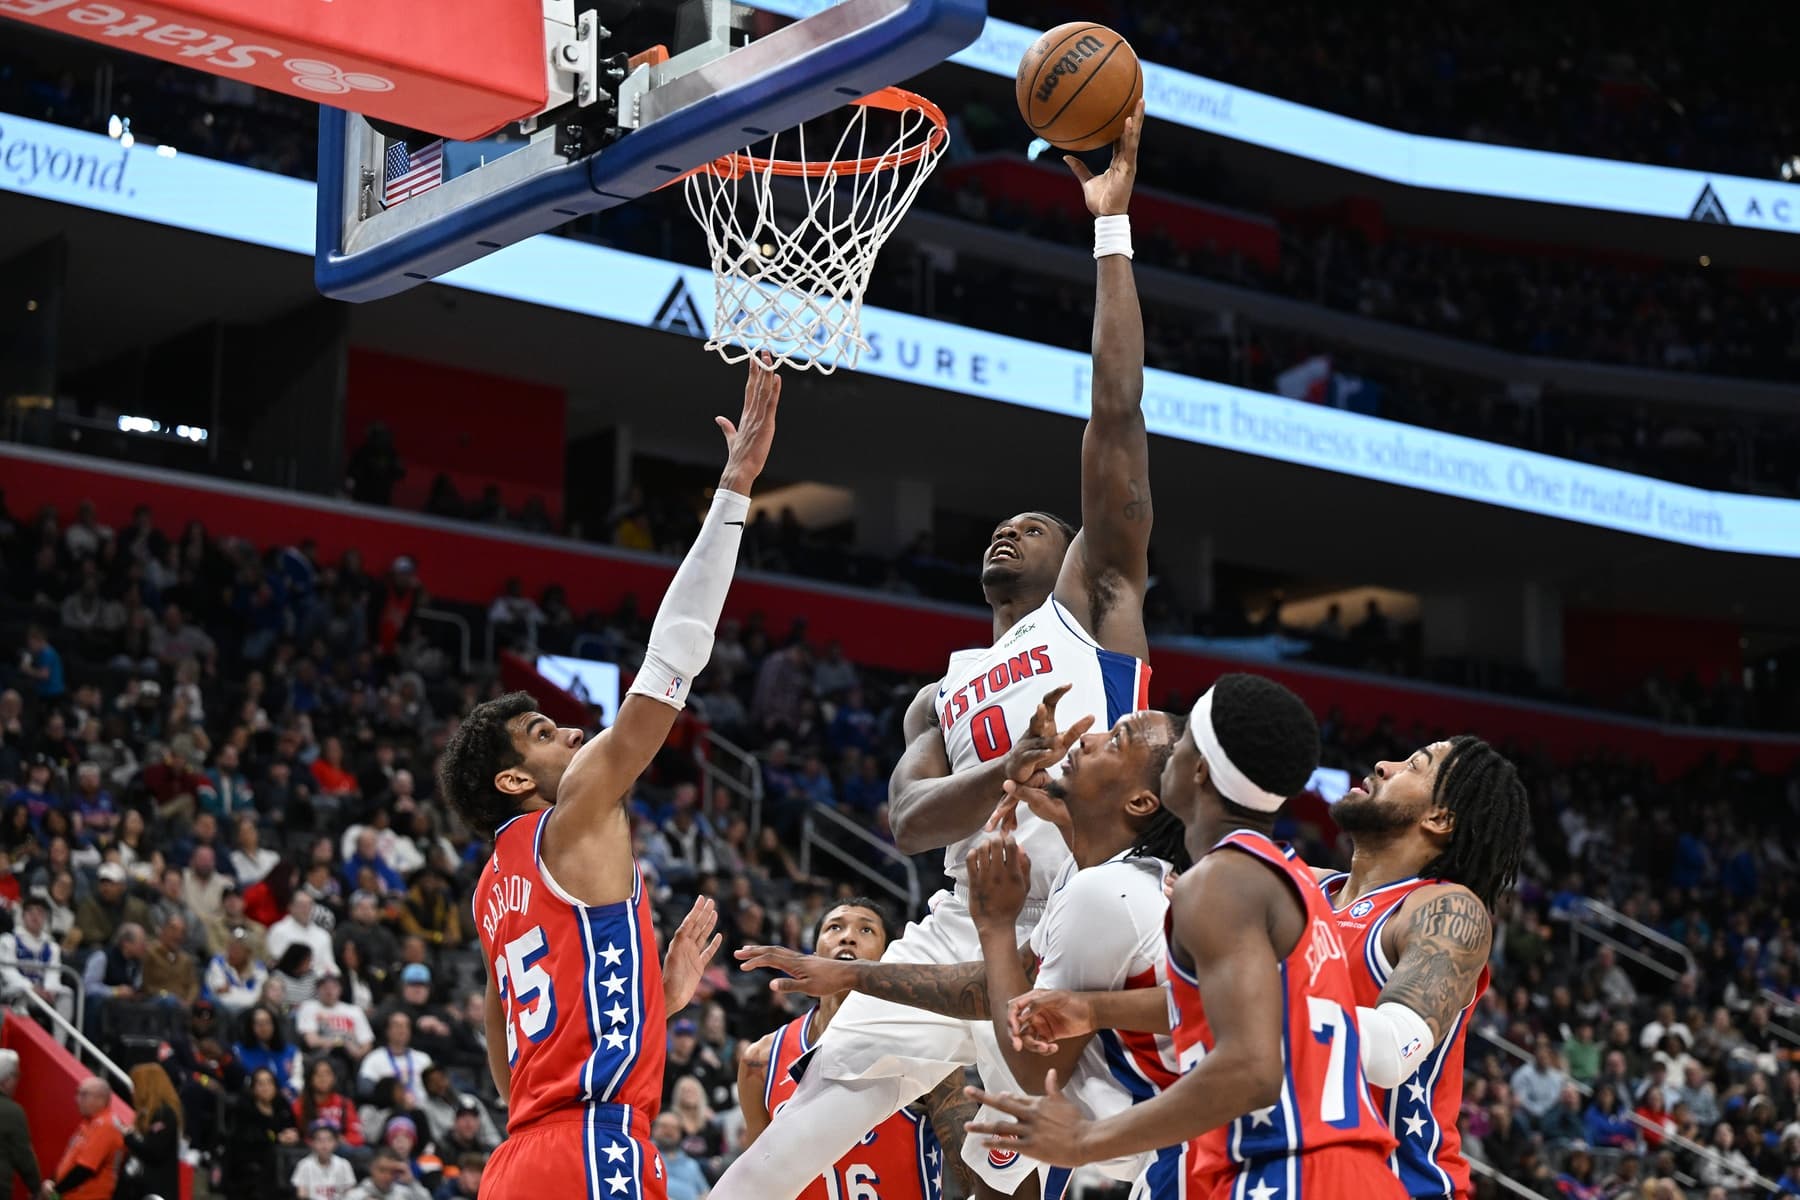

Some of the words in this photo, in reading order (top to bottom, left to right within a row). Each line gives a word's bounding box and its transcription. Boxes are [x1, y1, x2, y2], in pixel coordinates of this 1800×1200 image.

[1036, 34, 1105, 103] Wilson
[0, 124, 136, 198] eyond.
[1230, 398, 1357, 460] business
[1364, 433, 1496, 491] solutions.
[1506, 460, 1566, 504] One
[1656, 498, 1731, 540] team.
[970, 704, 1012, 762] 0
[1414, 897, 1444, 925] THE
[1449, 896, 1490, 932] WORL
[1421, 914, 1441, 937] IS
